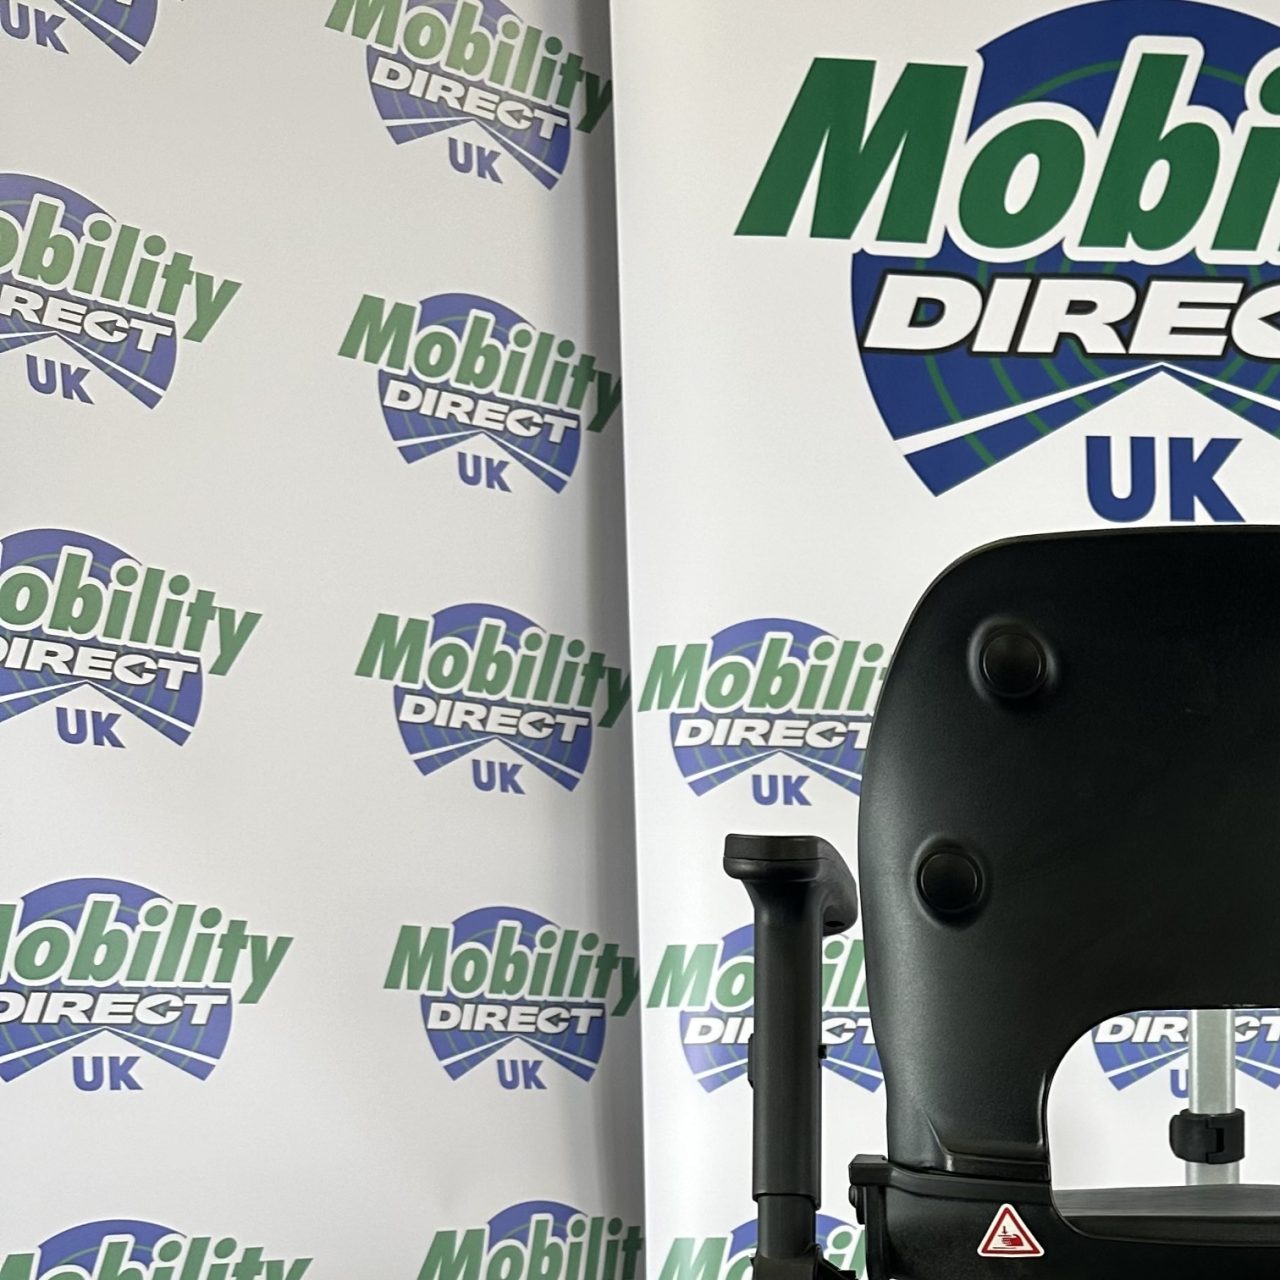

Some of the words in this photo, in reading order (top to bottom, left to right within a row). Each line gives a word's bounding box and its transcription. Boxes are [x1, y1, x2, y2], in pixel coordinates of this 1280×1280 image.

[0, 0, 69, 54] UK
[325, 0, 612, 134] Mobility
[371, 56, 568, 139] DIRECT
[448, 137, 503, 184] UK
[0, 285, 172, 352] RECT
[26, 354, 94, 405] UK
[337, 294, 622, 433] Mobility
[383, 380, 578, 443] DIRECT
[457, 451, 512, 493] UK
[1085, 436, 1245, 523] UK
[0, 553, 263, 676] obility
[0, 637, 198, 690] IRECT
[354, 613, 631, 728] Mobility
[637, 638, 887, 712] Mobili
[56, 706, 125, 748] UK
[399, 695, 589, 742] DIRECT
[674, 719, 871, 749] DIRECT
[472, 759, 525, 795] UK
[752, 774, 812, 806] UK
[0, 901, 293, 1004] obility
[427, 1002, 603, 1034] DIRECT
[73, 1056, 143, 1091] UK
[497, 1059, 547, 1090] UK
